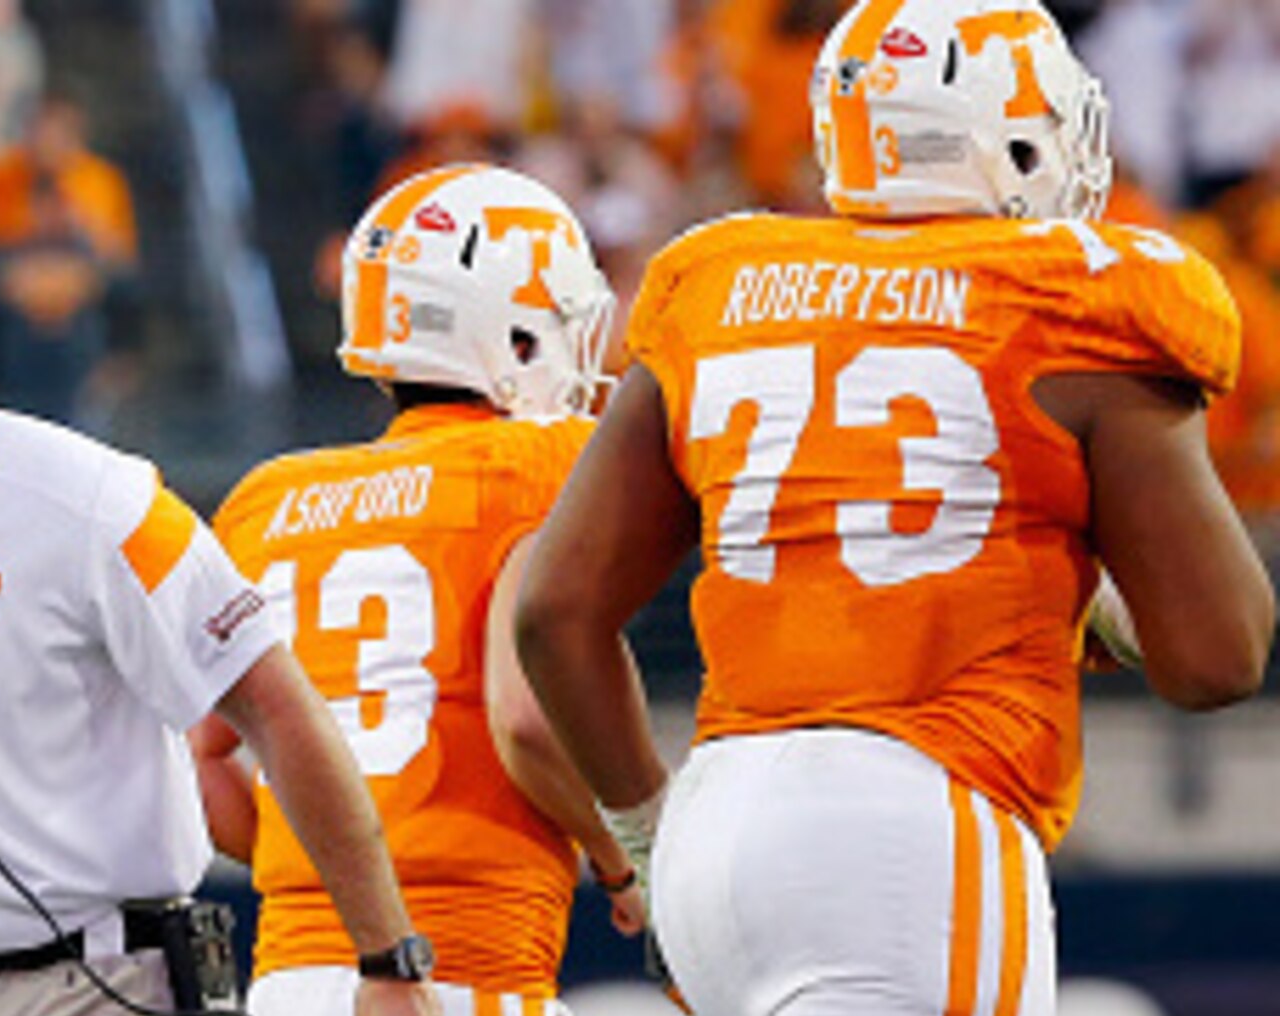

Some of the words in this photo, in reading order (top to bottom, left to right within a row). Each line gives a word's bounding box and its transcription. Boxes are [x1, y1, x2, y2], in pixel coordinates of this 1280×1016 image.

[482, 206, 578, 311] T
[721, 262, 971, 330] ROBERTSON
[263, 465, 433, 541] ASHFORD
[688, 344, 1001, 588] 73
